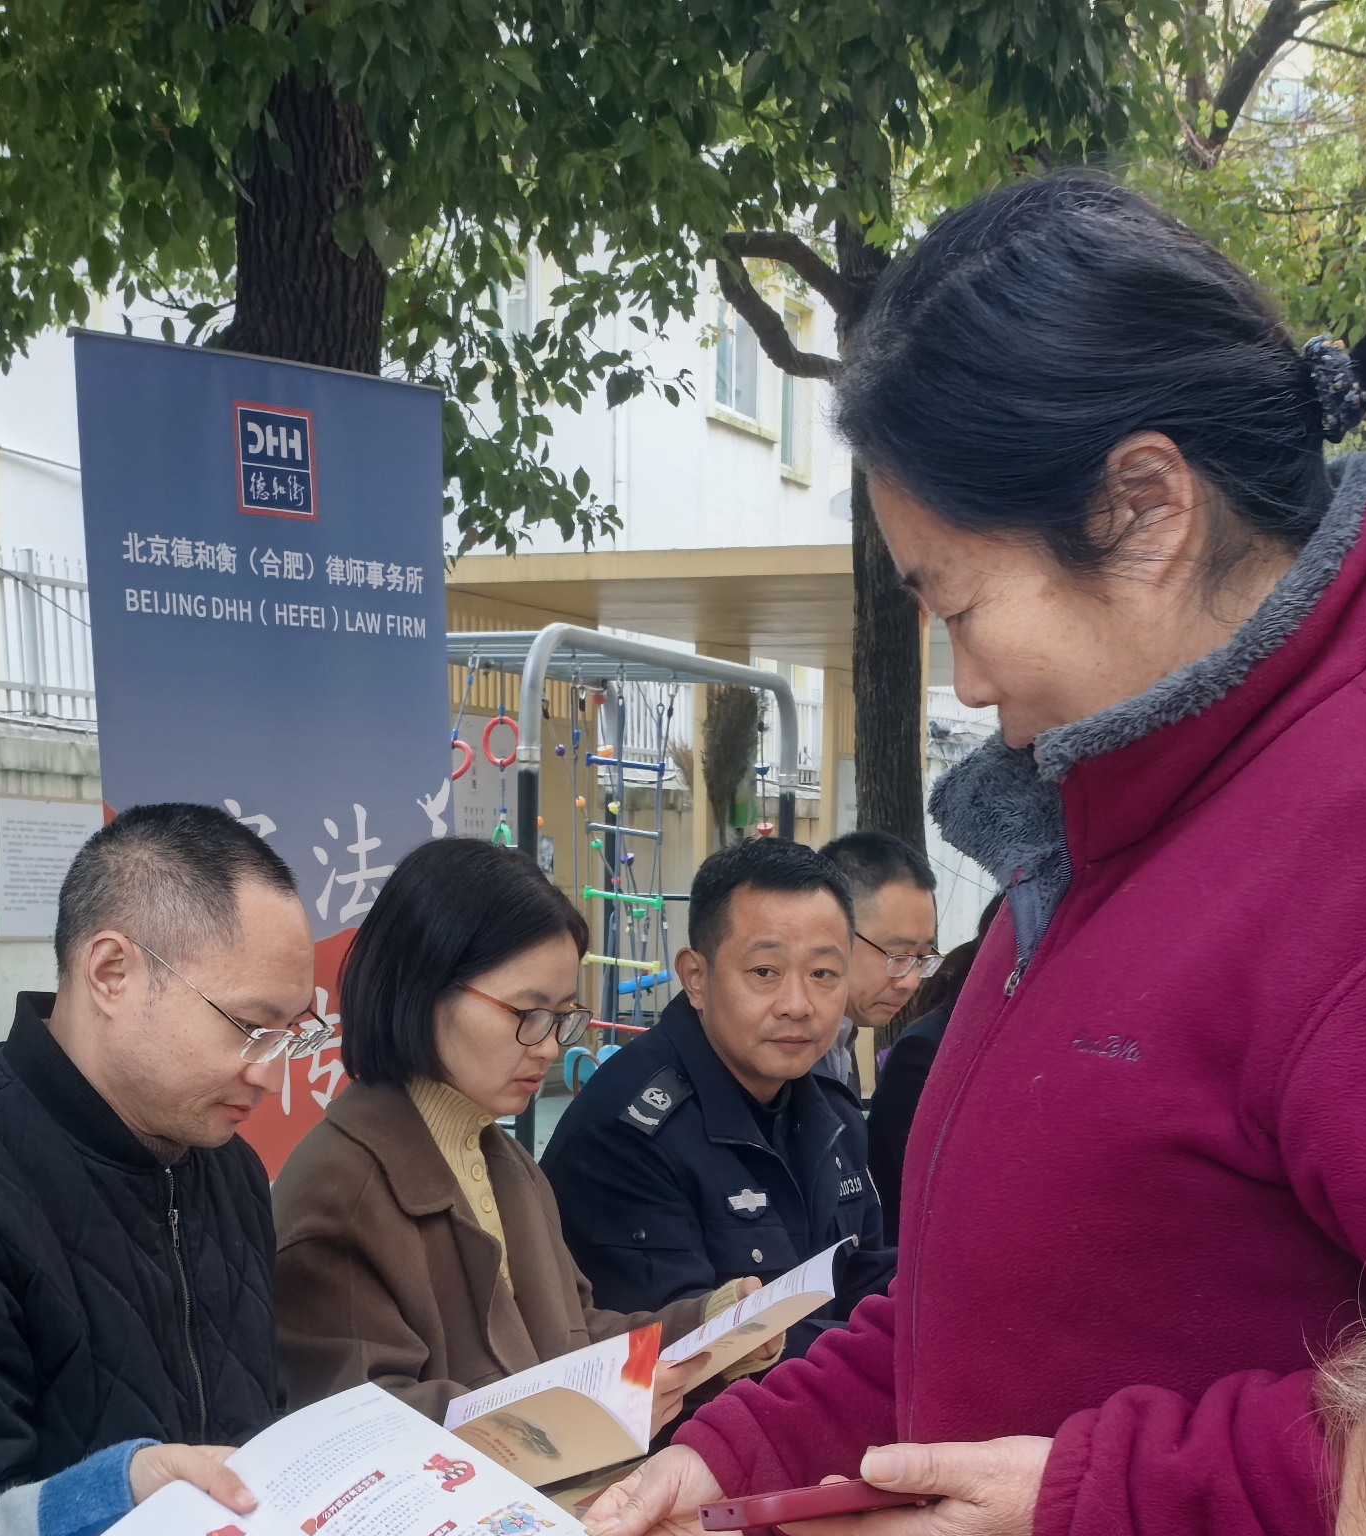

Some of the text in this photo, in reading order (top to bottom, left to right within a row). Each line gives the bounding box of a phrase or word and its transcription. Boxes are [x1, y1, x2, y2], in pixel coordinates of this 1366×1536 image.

[122, 532, 424, 595] 北京德和衡（合肥）律师事务所
[125, 588, 207, 618] BEIJING
[211, 596, 253, 623] DHH
[344, 609, 382, 634] LAW
[386, 614, 426, 639] FIRM
